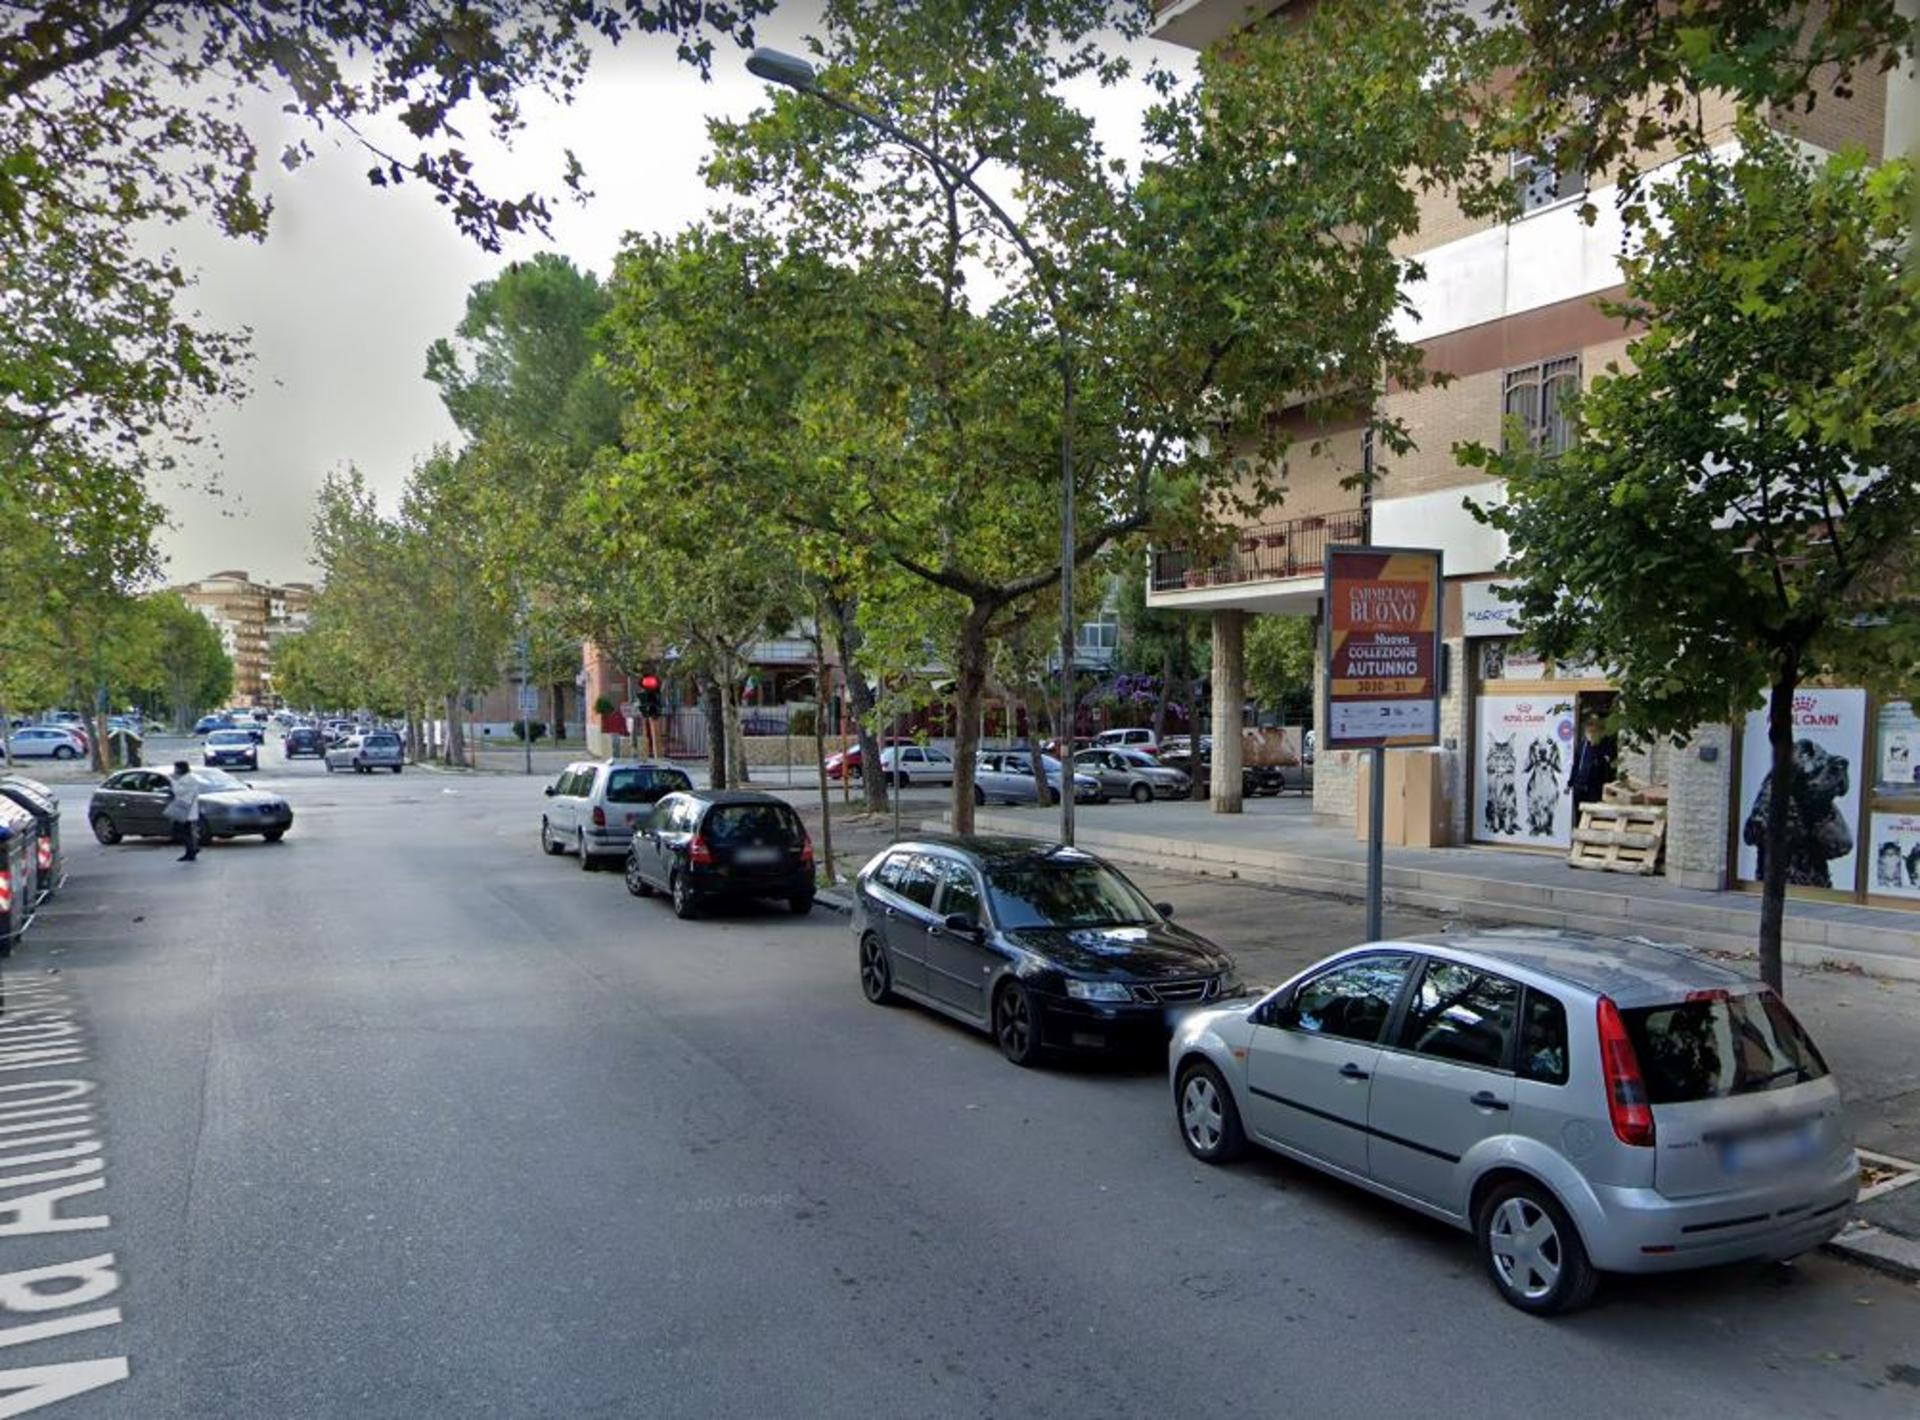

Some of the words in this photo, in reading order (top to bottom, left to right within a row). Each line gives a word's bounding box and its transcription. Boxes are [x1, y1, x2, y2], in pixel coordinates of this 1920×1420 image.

[1350, 601, 1416, 623] BUONO
[1466, 608, 1514, 621] MARKET
[1374, 632, 1410, 645] Nuova
[1348, 646, 1418, 659] COLLEZIONE
[1346, 661, 1418, 677] AUTUNNO
[1802, 714, 1839, 726] CANIN
